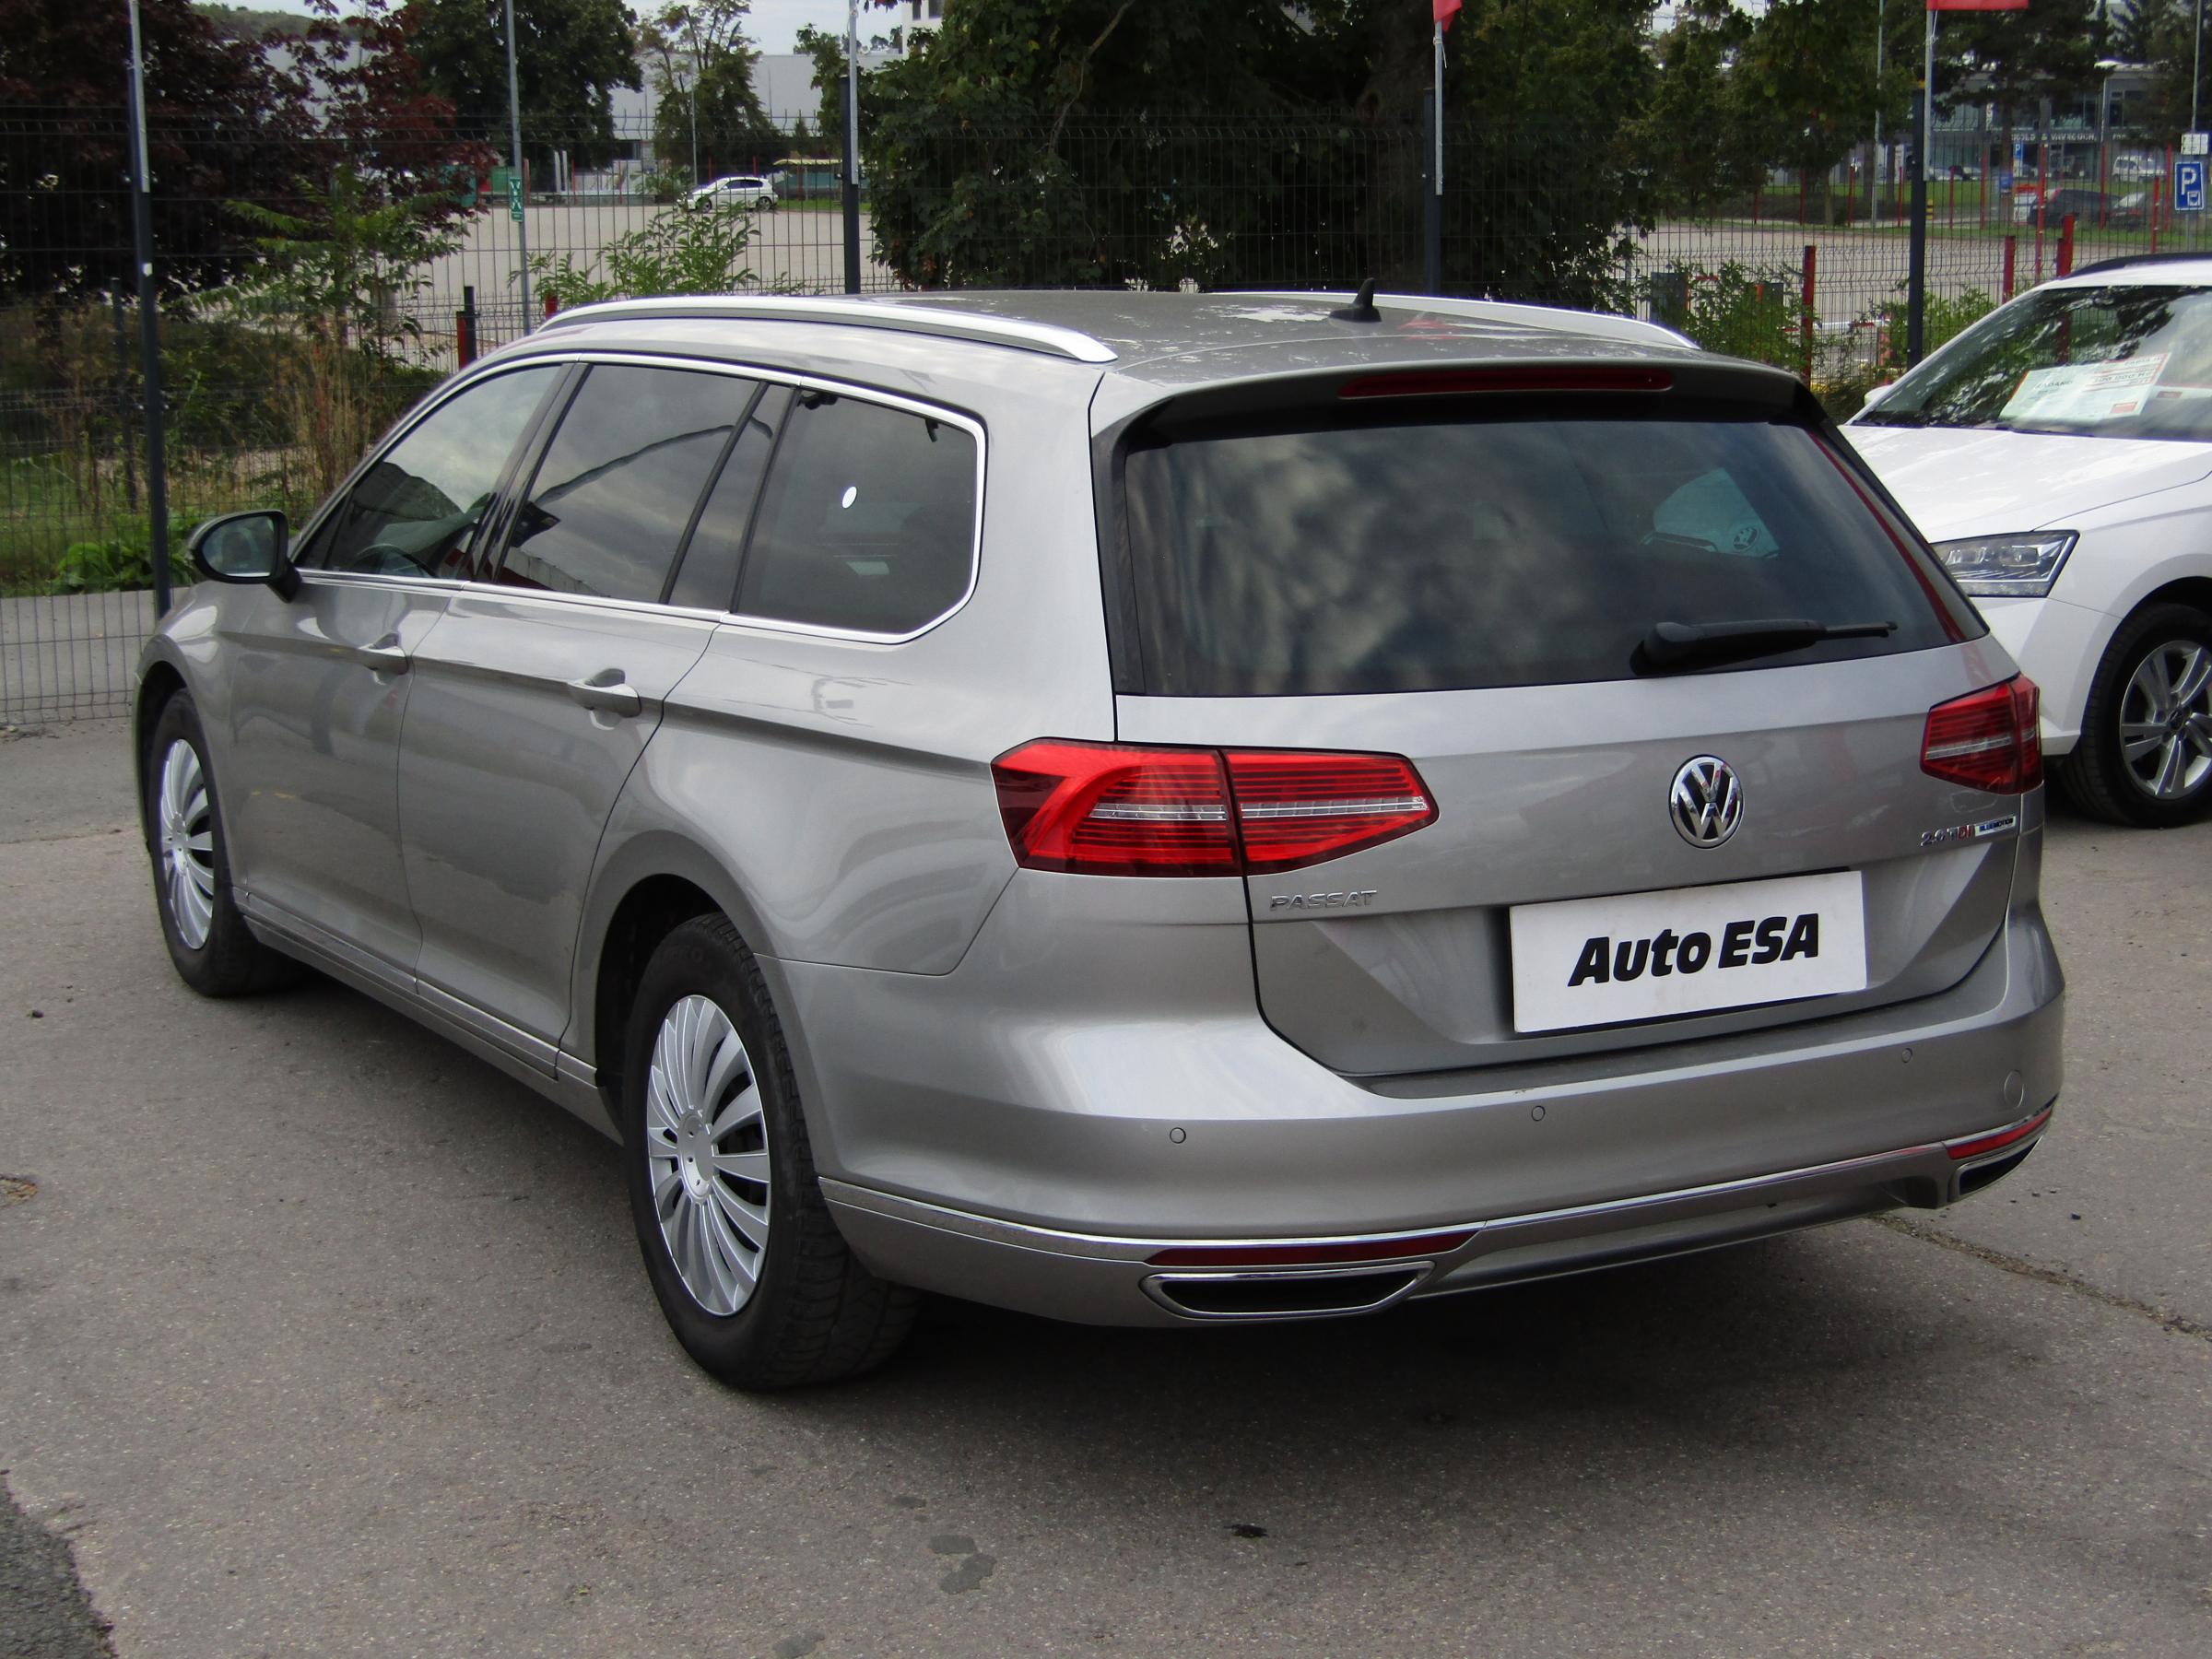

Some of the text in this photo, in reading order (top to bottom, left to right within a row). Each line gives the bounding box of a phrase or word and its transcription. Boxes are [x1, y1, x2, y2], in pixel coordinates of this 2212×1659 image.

[2181, 167, 2197, 195] P
[1270, 889, 1377, 911] PASSAT
[1567, 912, 1818, 987] Auto ESA
